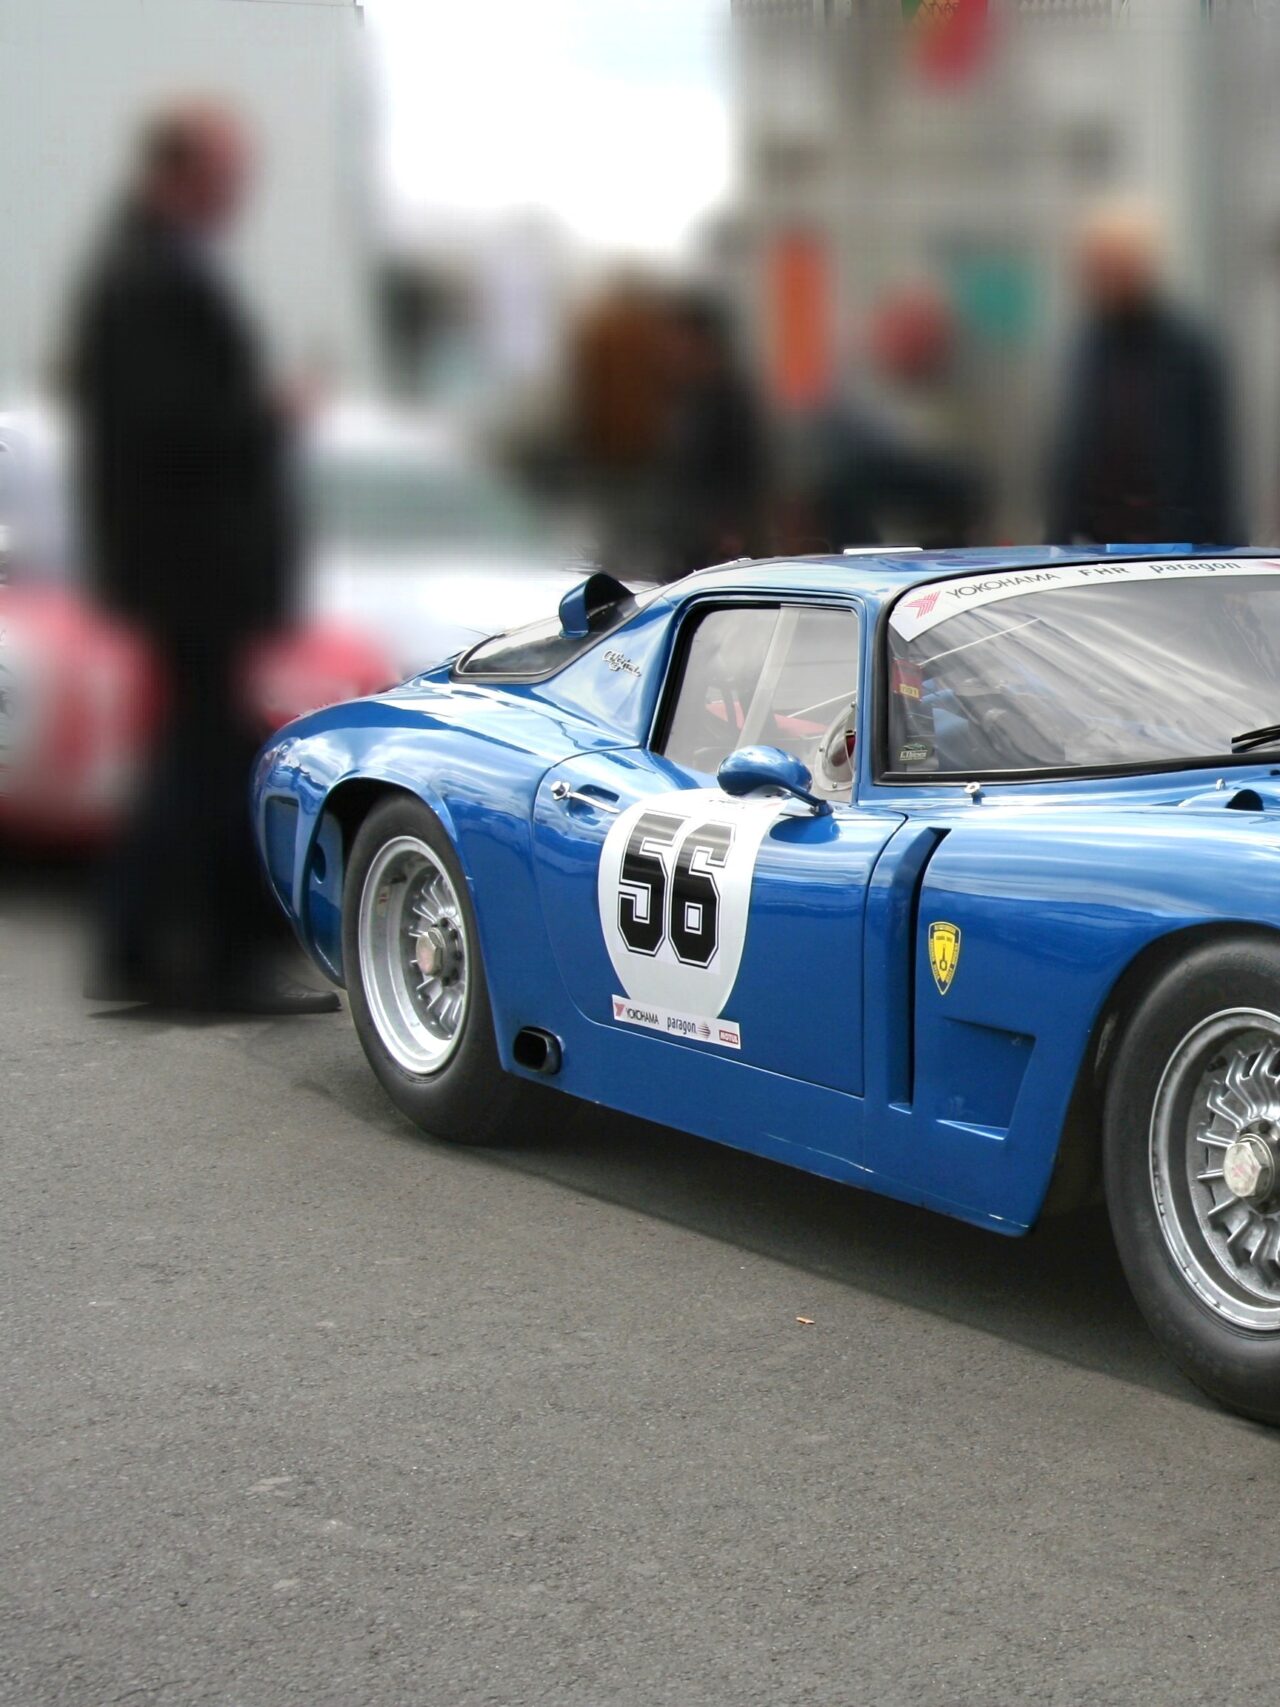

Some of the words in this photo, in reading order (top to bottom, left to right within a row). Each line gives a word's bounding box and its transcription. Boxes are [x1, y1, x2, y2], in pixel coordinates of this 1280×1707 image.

[945, 572, 1062, 599] YOKOHAMA
[1077, 567, 1130, 577] FHR
[1148, 561, 1242, 574] paragon
[617, 808, 736, 970] 56
[625, 1006, 660, 1025] YOKOHAMA
[667, 1016, 697, 1034] paragon
